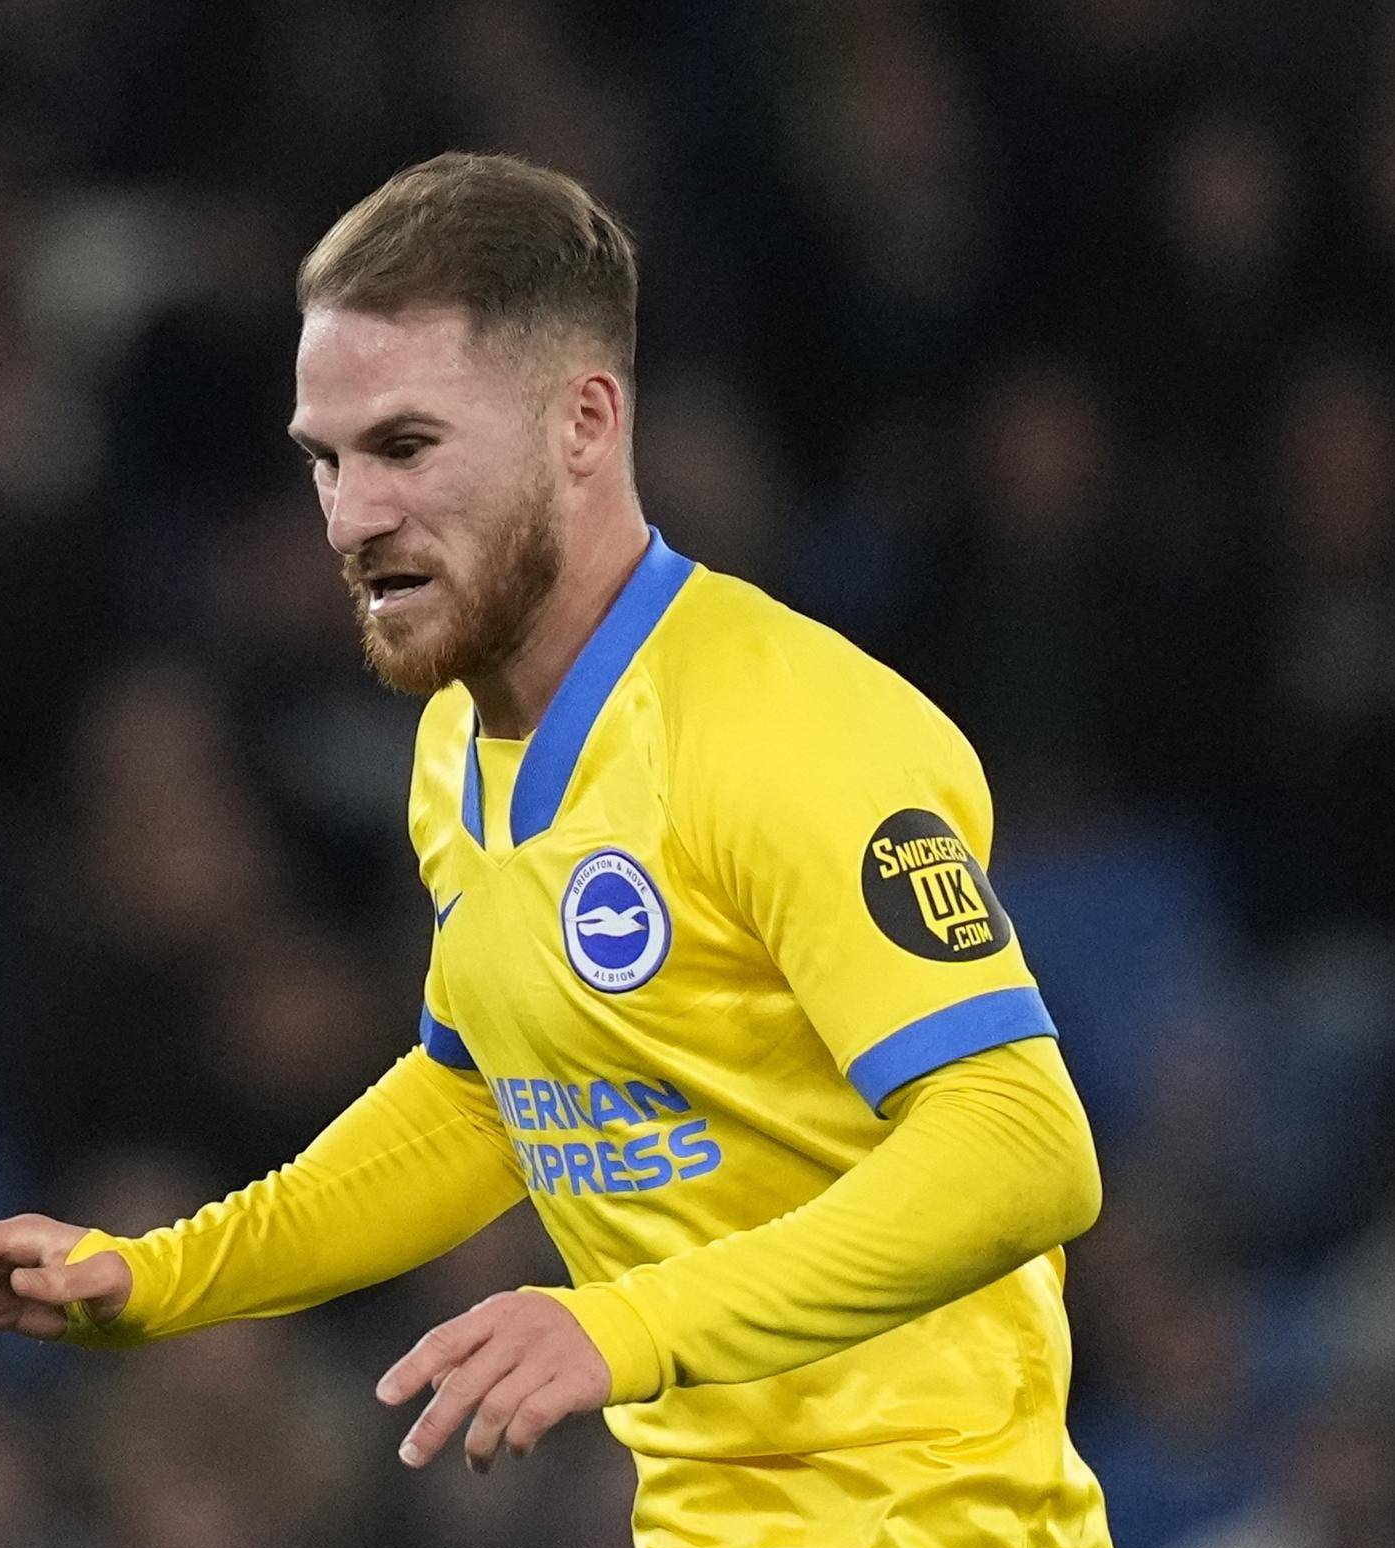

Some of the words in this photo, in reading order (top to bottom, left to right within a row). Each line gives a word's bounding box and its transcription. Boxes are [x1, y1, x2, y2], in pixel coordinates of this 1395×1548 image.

[573, 859, 612, 896] BRIGHTON
[616, 861, 623, 872] &
[625, 867, 649, 895] HOVE
[871, 836, 968, 880] SNICKERS
[920, 868, 978, 921] UK
[952, 921, 993, 953] .COM
[593, 968, 636, 984] ALBION
[512, 1118, 722, 1196] XPRESS
